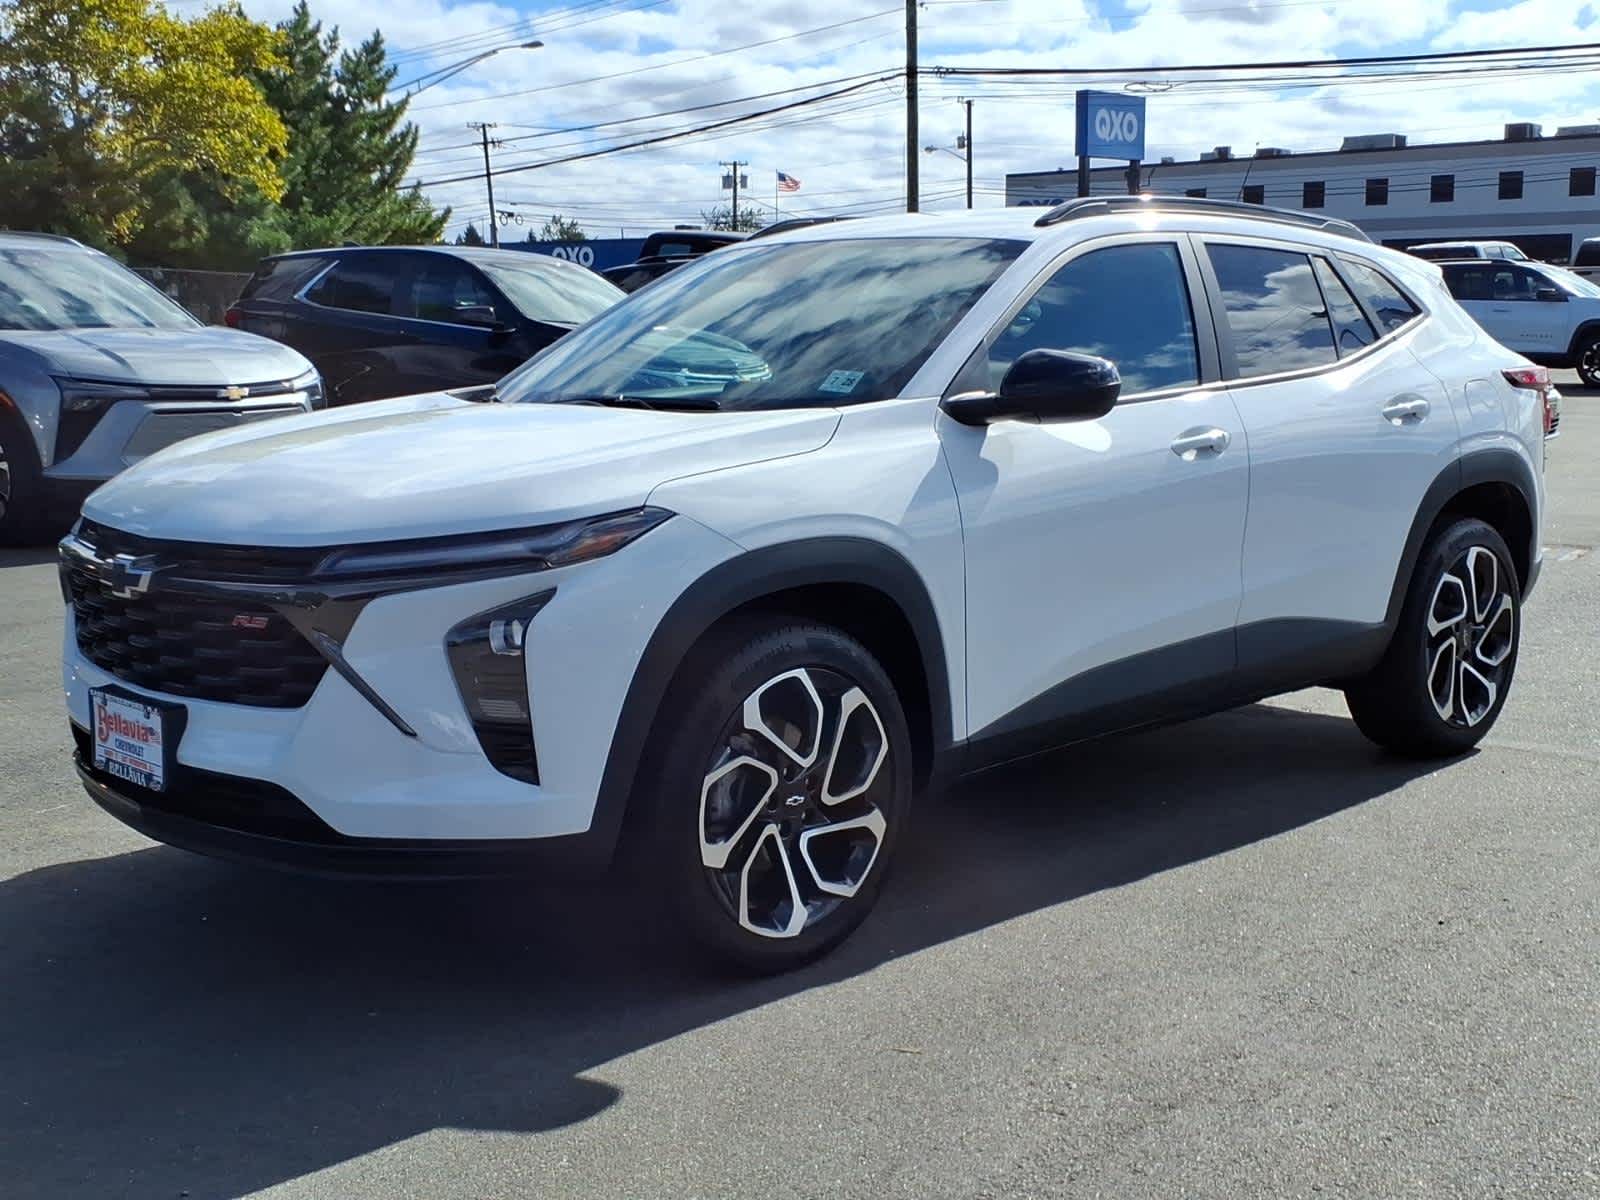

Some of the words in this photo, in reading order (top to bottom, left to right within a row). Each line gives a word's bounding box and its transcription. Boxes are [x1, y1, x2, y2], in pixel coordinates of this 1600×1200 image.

[1096, 108, 1138, 143] QXO
[232, 615, 269, 629] RS
[97, 704, 150, 743] Bellavia
[109, 761, 147, 788] BELLAVIA
